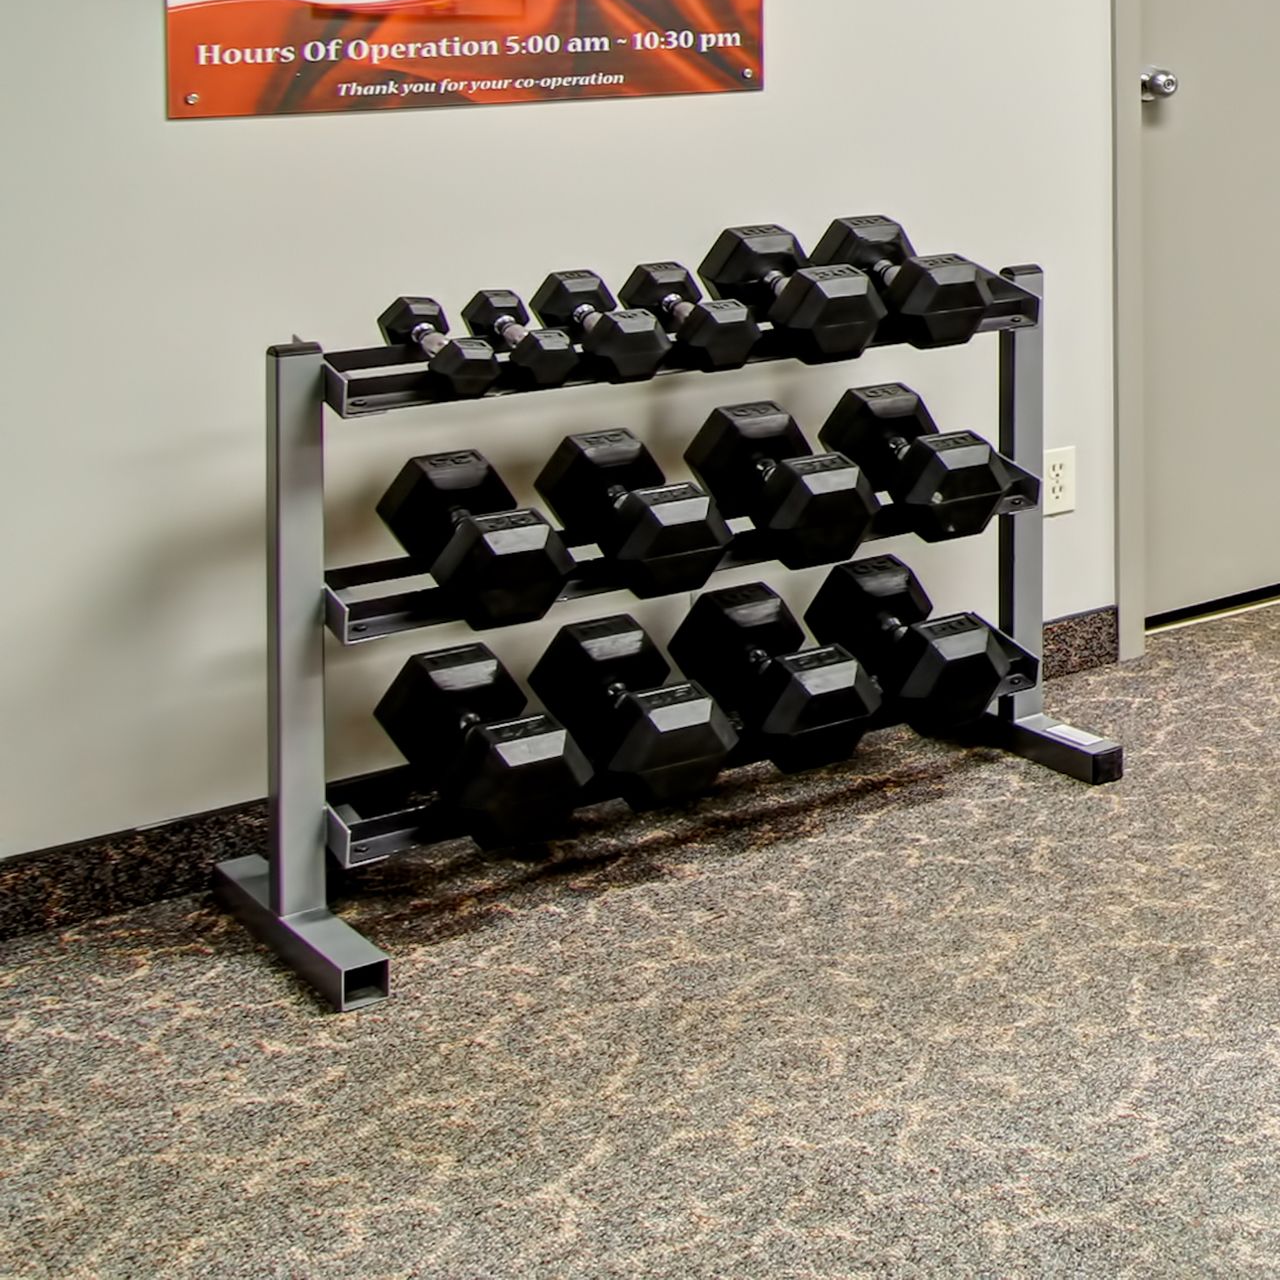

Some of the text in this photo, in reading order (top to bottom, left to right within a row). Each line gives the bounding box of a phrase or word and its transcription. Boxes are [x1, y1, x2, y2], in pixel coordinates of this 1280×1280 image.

[197, 43, 296, 66] Hours
[302, 38, 344, 63] Of
[346, 35, 499, 66] Operation
[505, 33, 561, 56] 5:00
[566, 35, 611, 54] am
[632, 29, 695, 51] 10:30
[699, 31, 742, 54] pm
[337, 71, 625, 98] Thank you for your co-operation
